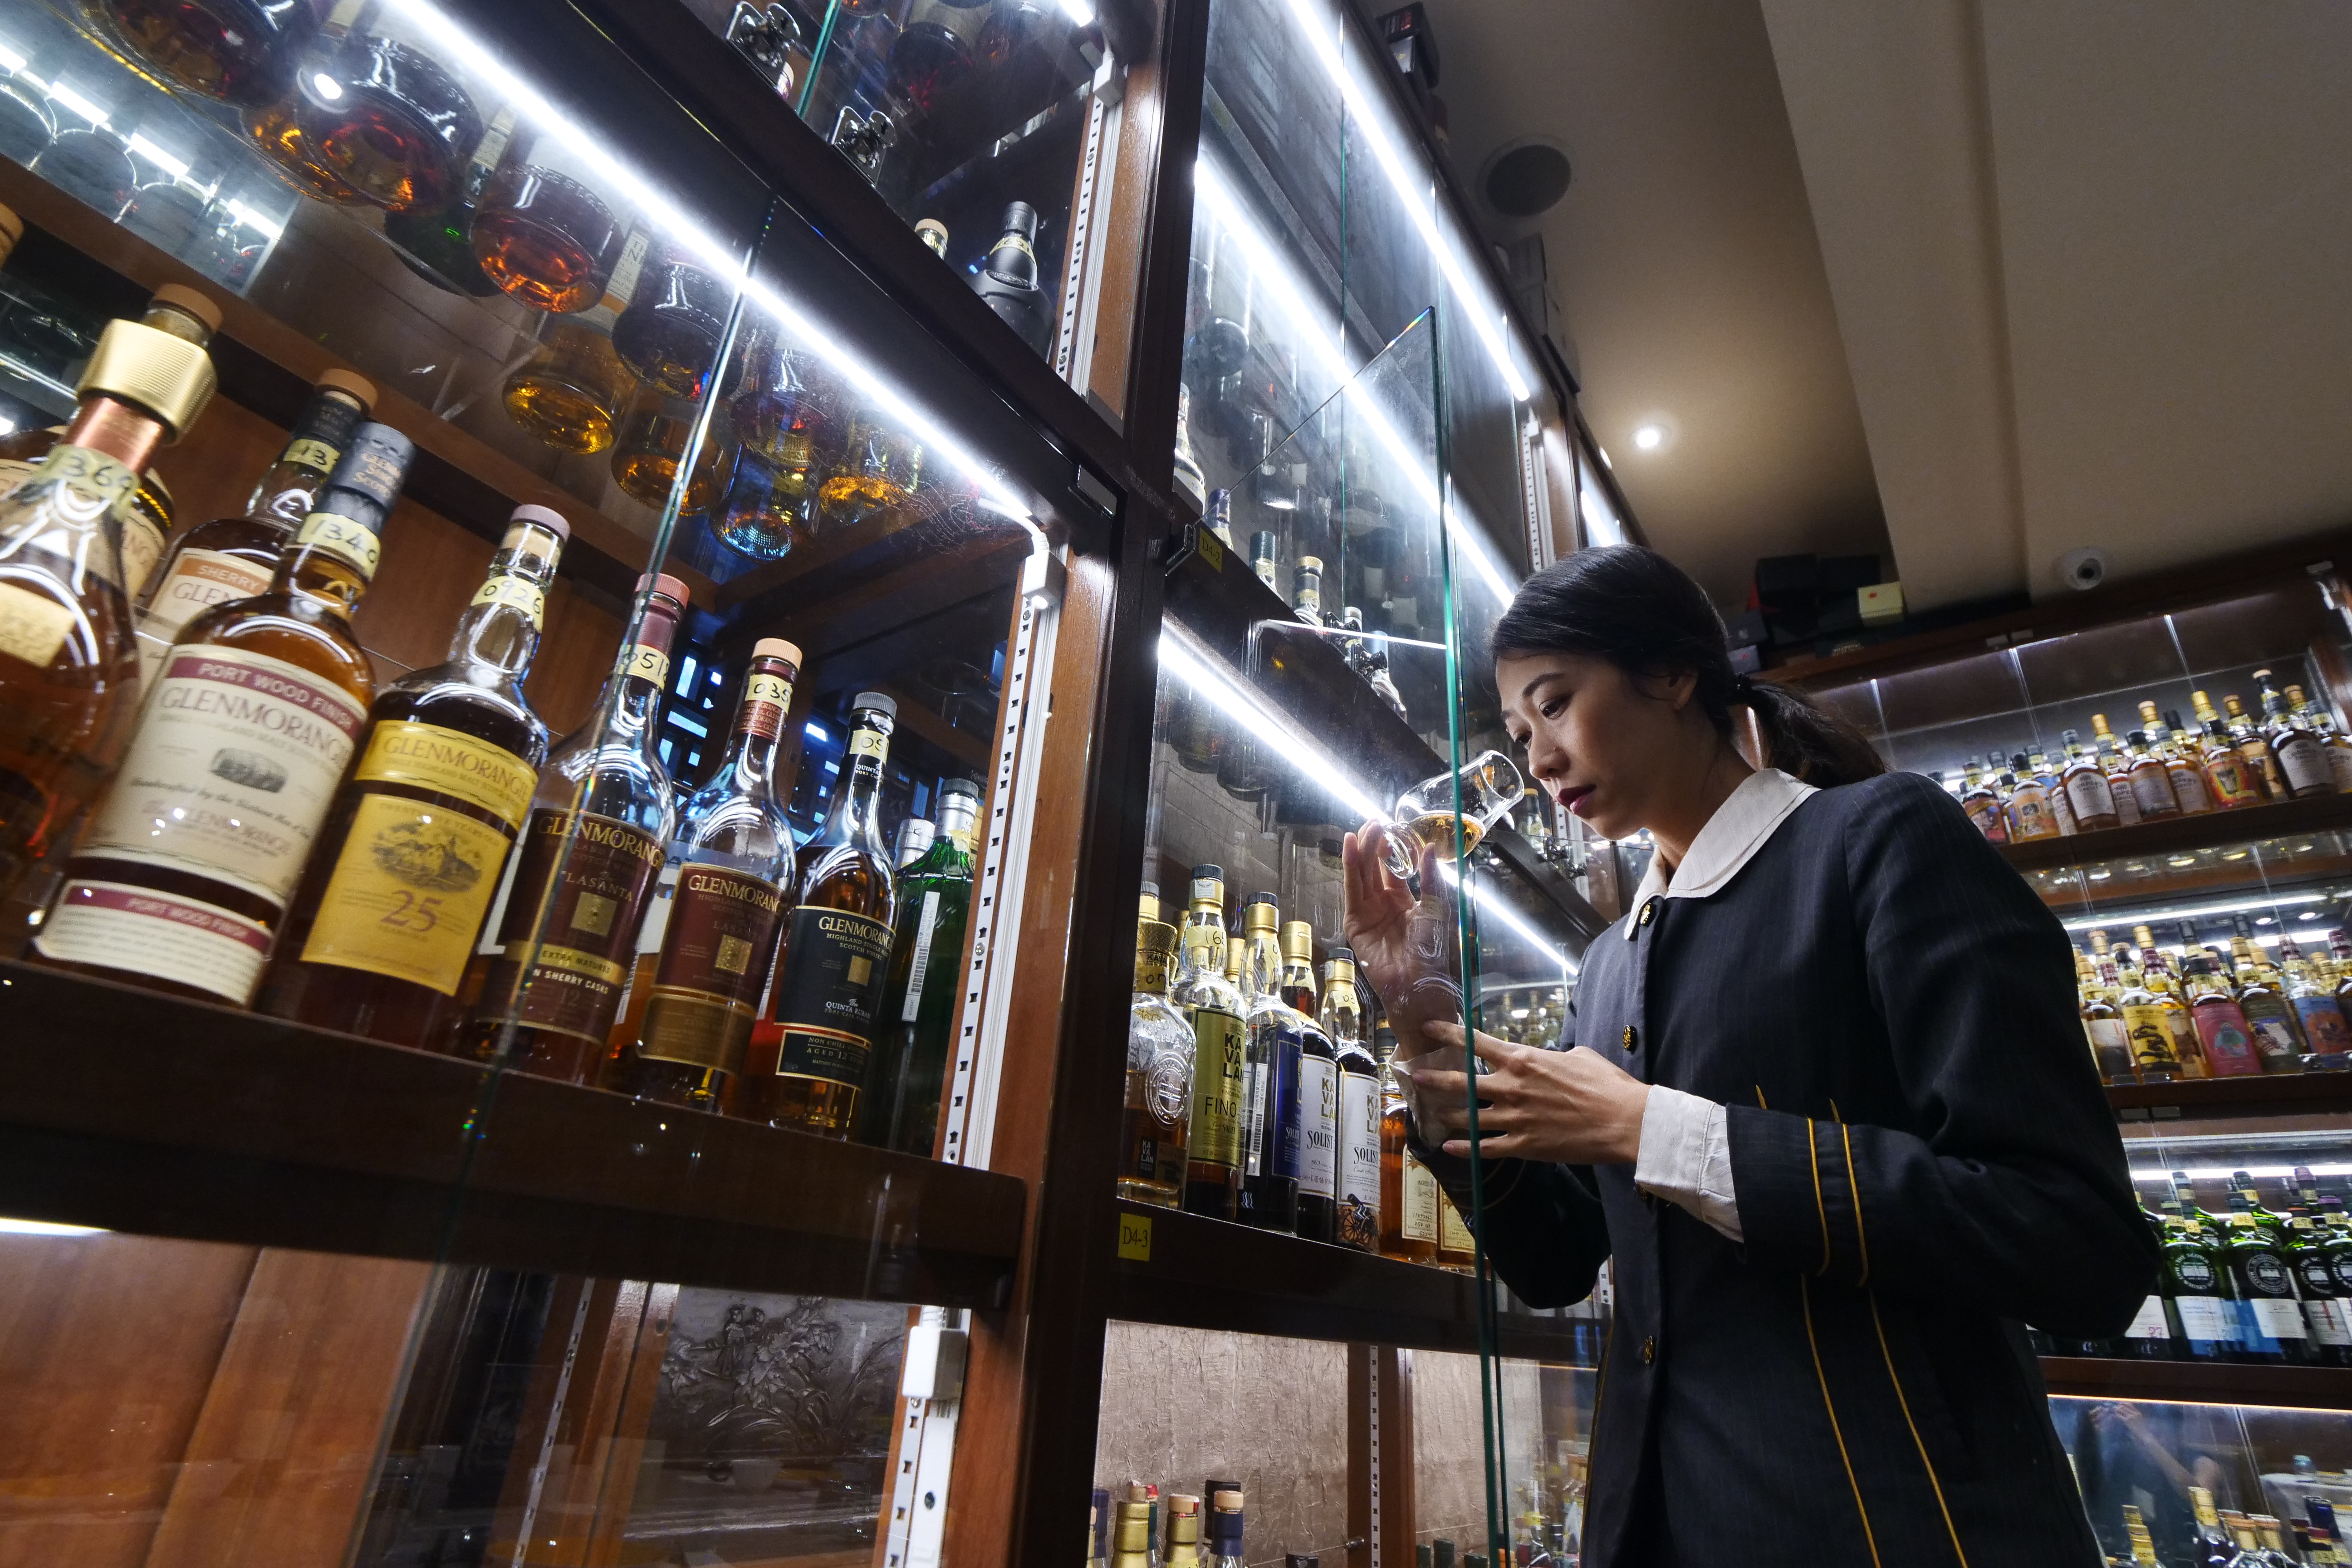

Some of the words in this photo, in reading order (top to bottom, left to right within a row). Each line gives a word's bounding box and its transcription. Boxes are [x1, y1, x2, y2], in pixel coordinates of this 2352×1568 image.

[1202, 538, 1220, 564] D4-2
[197, 565, 261, 590] SHERRY
[484, 580, 542, 614] 0926
[199, 662, 253, 683] PORT
[254, 674, 311, 704] WOOD
[160, 687, 348, 770] GLENMORANG
[383, 736, 529, 802] GLENMORANGIE
[537, 816, 665, 871] GLENMORANG
[688, 875, 781, 915] GLENMORANG
[381, 889, 444, 932] 25
[818, 916, 894, 953] GLENMORANG
[826, 933, 862, 945] HIGHLAND
[864, 941, 881, 952] SINGLE
[840, 942, 864, 953] SCOTCH
[544, 970, 583, 986] SHERRY
[585, 980, 609, 994] CASKS
[825, 1001, 853, 1013] QUINTA
[855, 1008, 871, 1019] RUBAN
[1225, 1033, 1242, 1053] KA
[807, 1048, 833, 1056] AGED
[838, 1051, 847, 1060] 12
[1225, 1048, 1241, 1067] VA
[1322, 1077, 1334, 1093] KA
[1204, 1097, 1237, 1117] FINO
[1322, 1089, 1334, 1106] VA
[1367, 1095, 1379, 1111] KA
[1367, 1107, 1379, 1123] VA
[1142, 1140, 1151, 1149] KA
[1307, 1130, 1333, 1149] SOLIST
[1141, 1154, 1154, 1164] LAN
[1142, 1147, 1151, 1156] VA
[1354, 1146, 1378, 1165] SOLIST
[1122, 1226, 1148, 1248] D4-3
